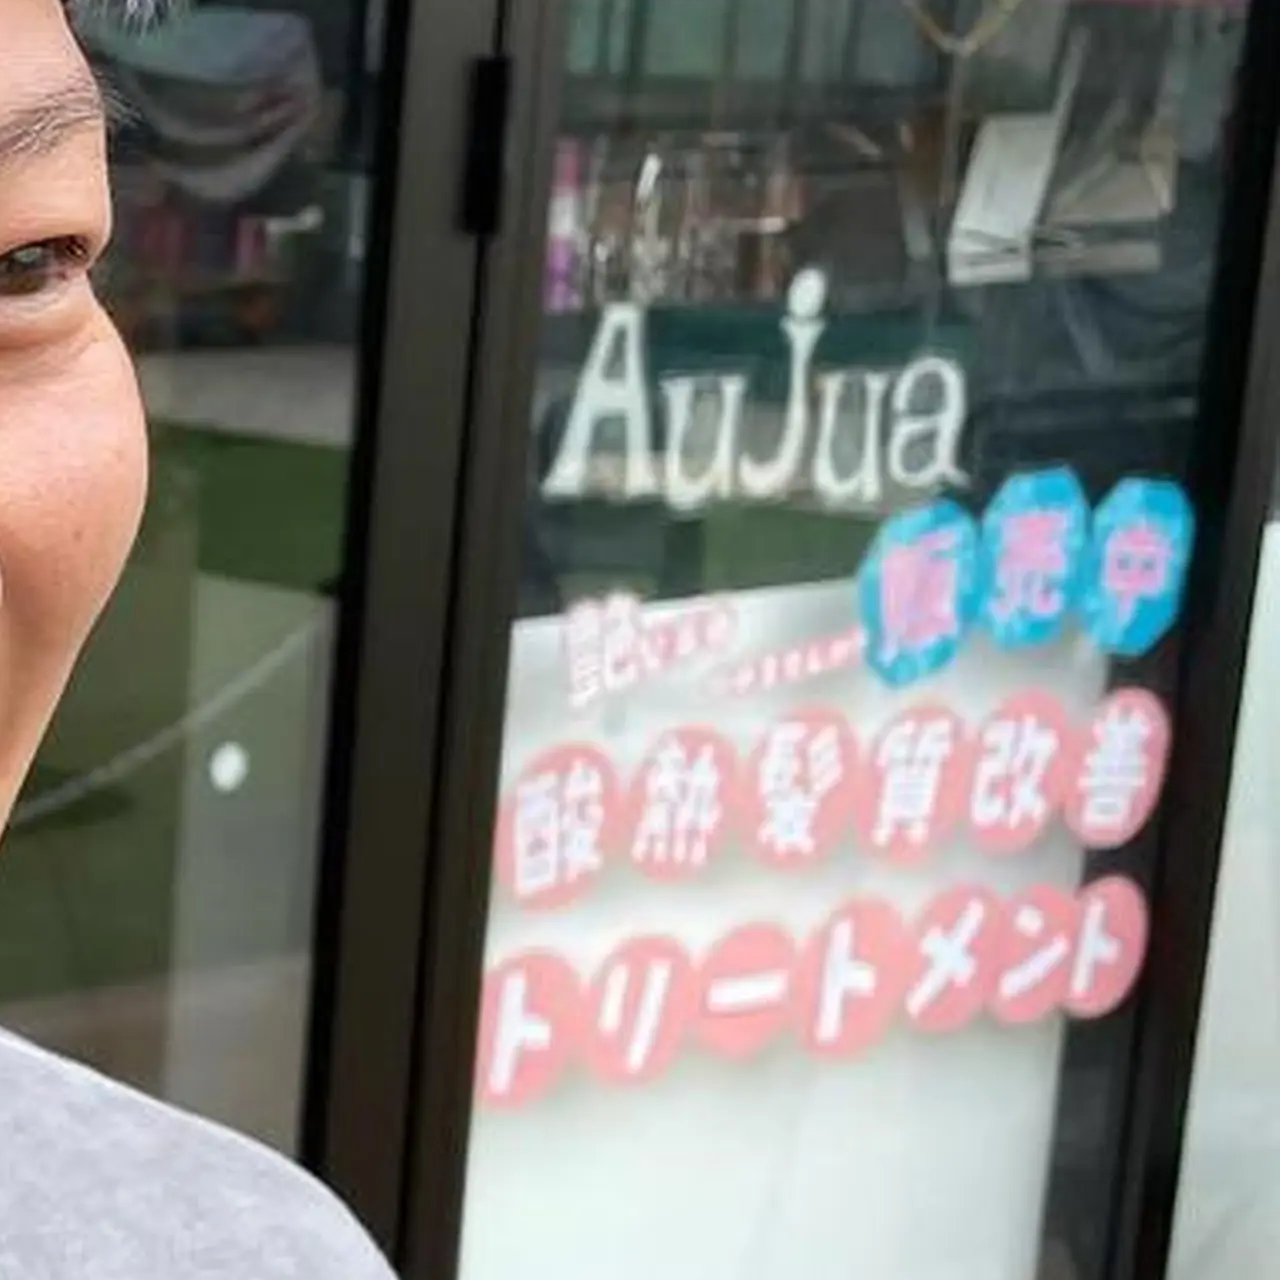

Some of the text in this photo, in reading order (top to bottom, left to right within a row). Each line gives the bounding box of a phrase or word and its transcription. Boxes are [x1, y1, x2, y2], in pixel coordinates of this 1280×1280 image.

[512, 702, 1151, 897] 酸熱髪質改善
[487, 898, 1123, 1096] トリートメント
